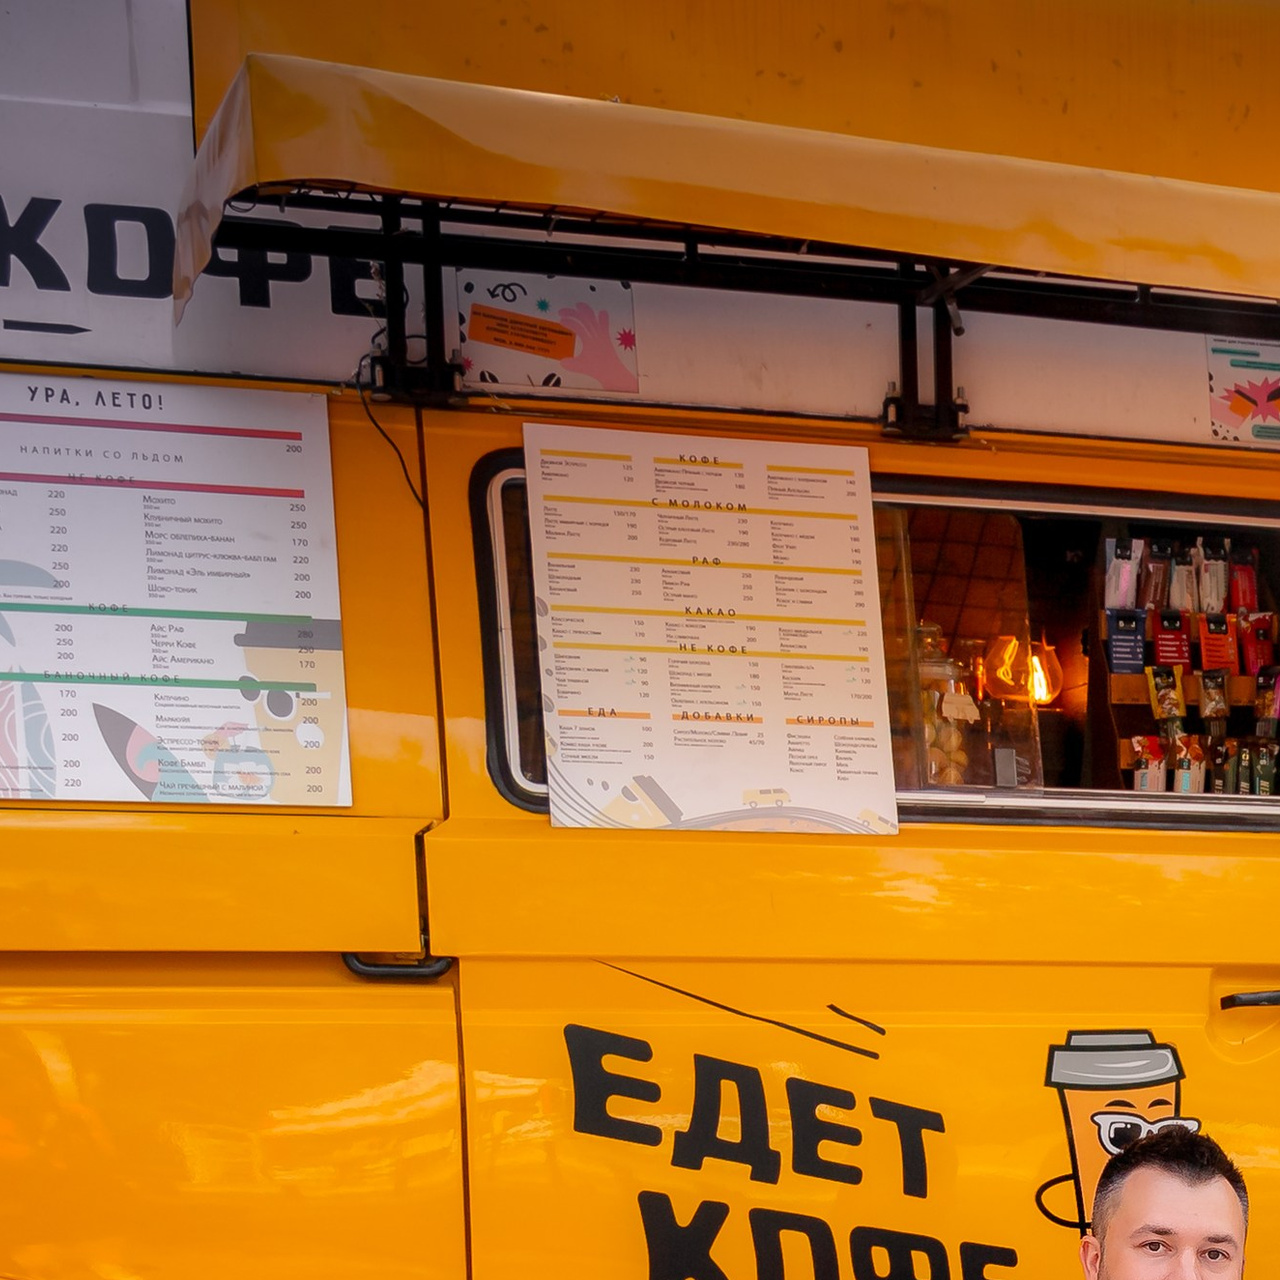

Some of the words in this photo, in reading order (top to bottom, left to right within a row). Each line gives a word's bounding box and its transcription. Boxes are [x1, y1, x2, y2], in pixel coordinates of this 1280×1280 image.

[27, 386, 80, 407] УРА,
[286, 444, 302, 453] 200
[20, 444, 94, 458] НАПИТКИ
[103, 450, 121, 459] СО
[131, 451, 185, 463] ЛЬДОМ
[680, 455, 719, 464] КОФЕ
[96, 474, 135, 483] КОФЕ
[48, 490, 65, 498] 220
[669, 499, 747, 511] МОЛОКОМ
[50, 508, 66, 516] 250
[50, 526, 67, 534] 220
[51, 544, 68, 552] 220
[693, 556, 721, 565] РАФ
[52, 562, 69, 570] 250
[53, 580, 70, 588] 200
[296, 591, 311, 599] 200
[89, 603, 128, 612] КОФЕ
[685, 607, 736, 617] КАКАО
[680, 644, 696, 652] НЕ
[707, 645, 747, 654] КОФЕ
[44, 671, 130, 680] БАНОЧНЫЙ
[140, 674, 180, 684] КОФЕ
[588, 707, 617, 717] ЕДА
[681, 711, 754, 721] ДОБАВКИ
[797, 715, 859, 725] СИРОПЫ
[63, 760, 80, 768] 200
[65, 779, 81, 787] 220
[564, 1023, 945, 1199] ЕДЕТ
